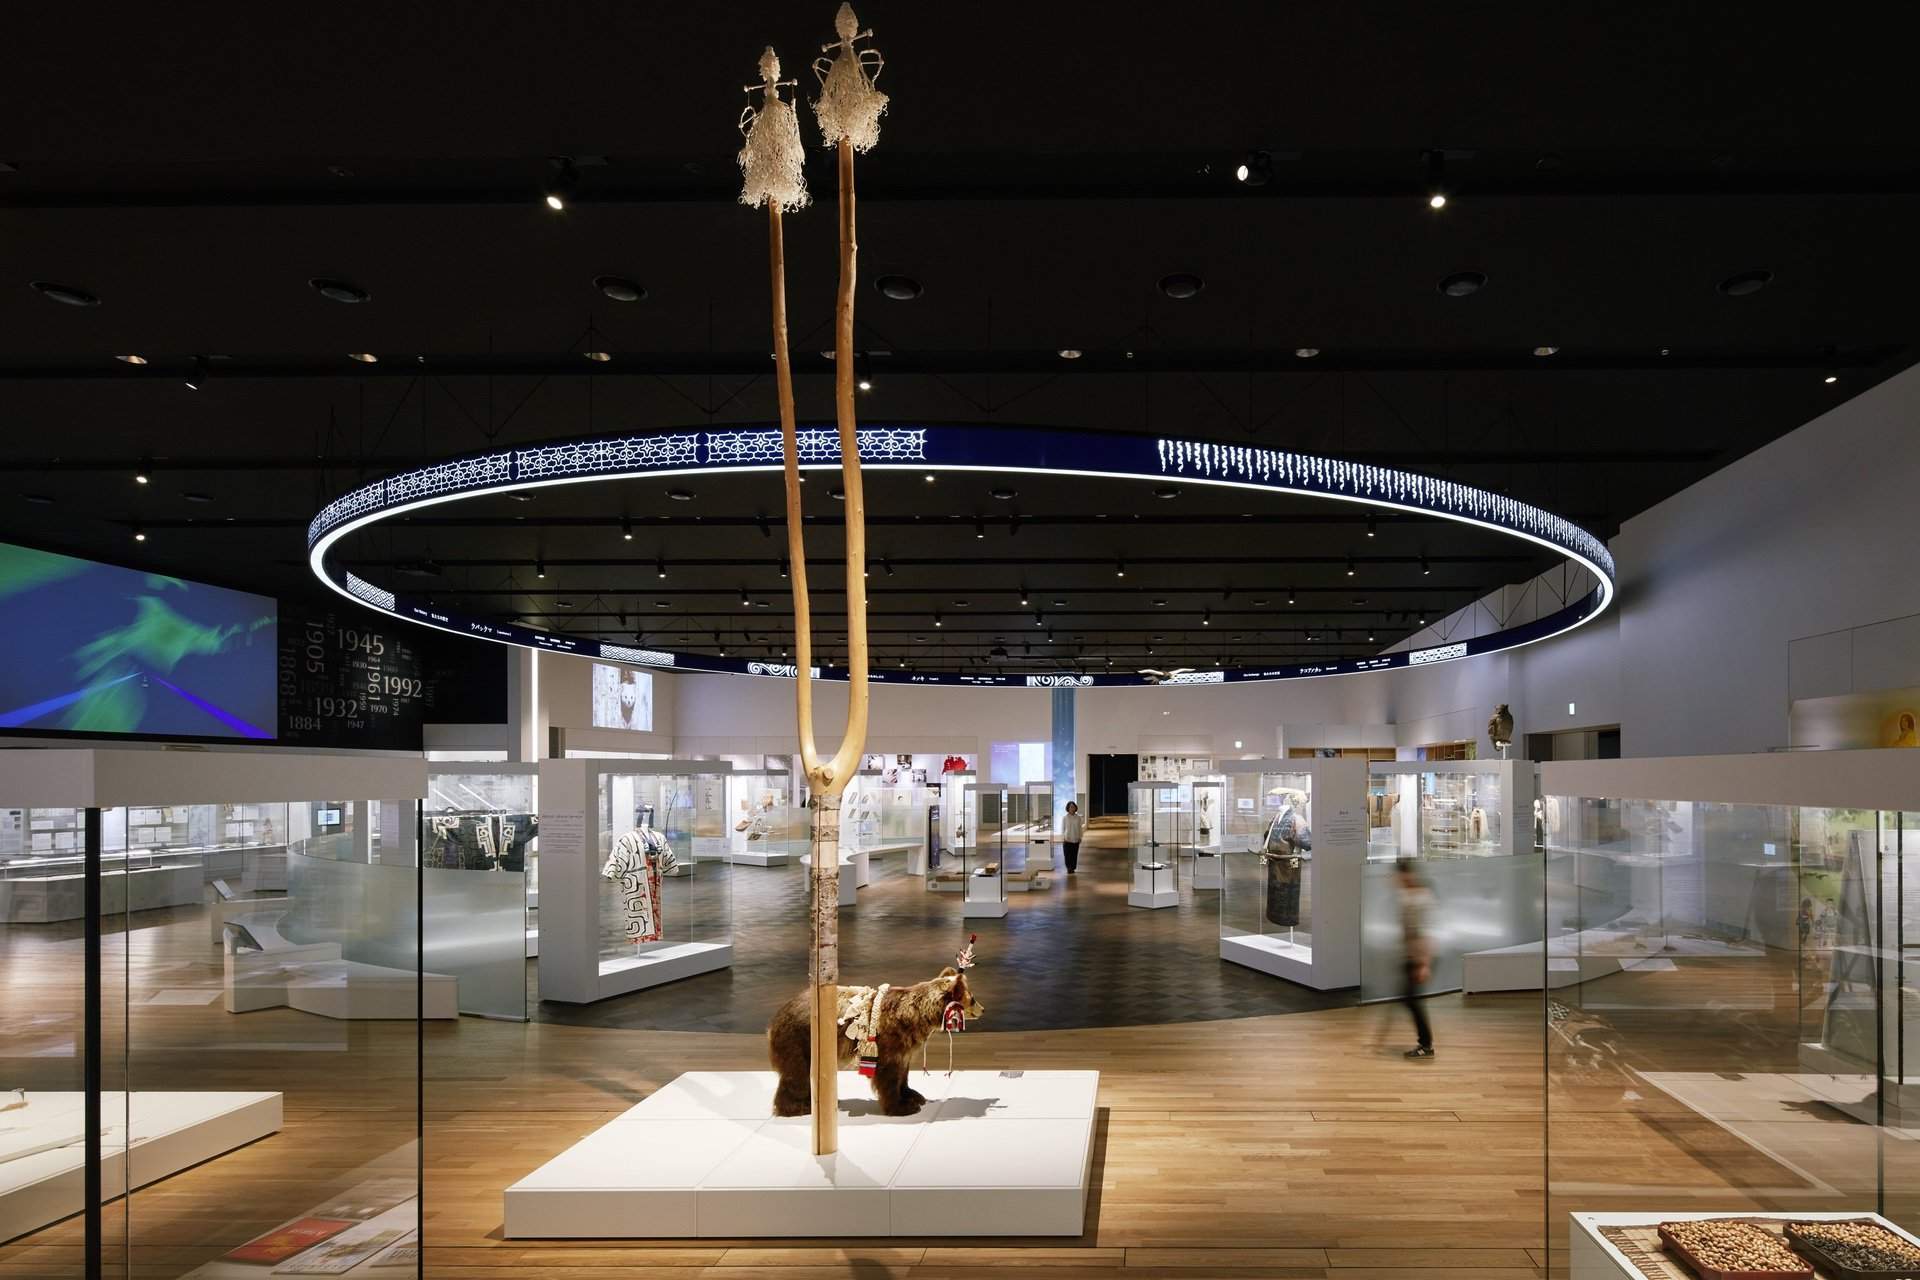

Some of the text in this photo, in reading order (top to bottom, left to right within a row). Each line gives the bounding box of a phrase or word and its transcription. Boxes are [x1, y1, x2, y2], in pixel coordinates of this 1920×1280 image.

[305, 621, 325, 674] 1905
[336, 628, 385, 657] 1945
[279, 648, 297, 696] 1868
[367, 665, 382, 701] 1961
[383, 675, 422, 699] 1992
[315, 696, 359, 719] 1932
[370, 703, 388, 714] 1970
[288, 715, 322, 731] 1884
